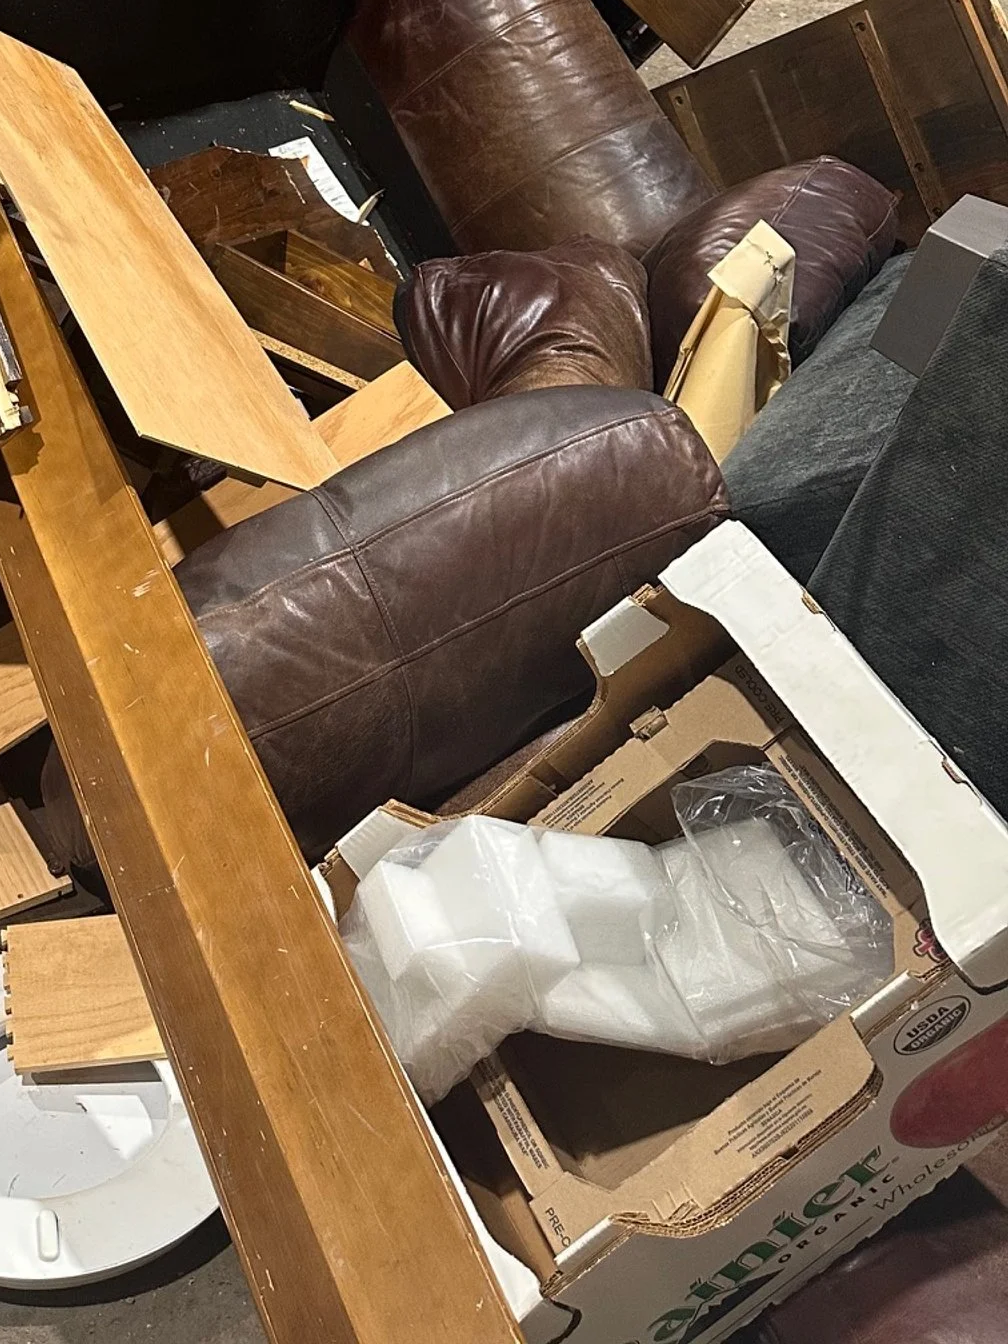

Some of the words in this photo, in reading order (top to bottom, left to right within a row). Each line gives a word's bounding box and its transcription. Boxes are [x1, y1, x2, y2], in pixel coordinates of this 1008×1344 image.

[906, 1004, 950, 1040] USDA
[909, 1009, 964, 1051] ORGANIC
[545, 1206, 571, 1248] PRE-C
[777, 1172, 896, 1264] ORGANIC
[640, 1145, 882, 1344] ainier
